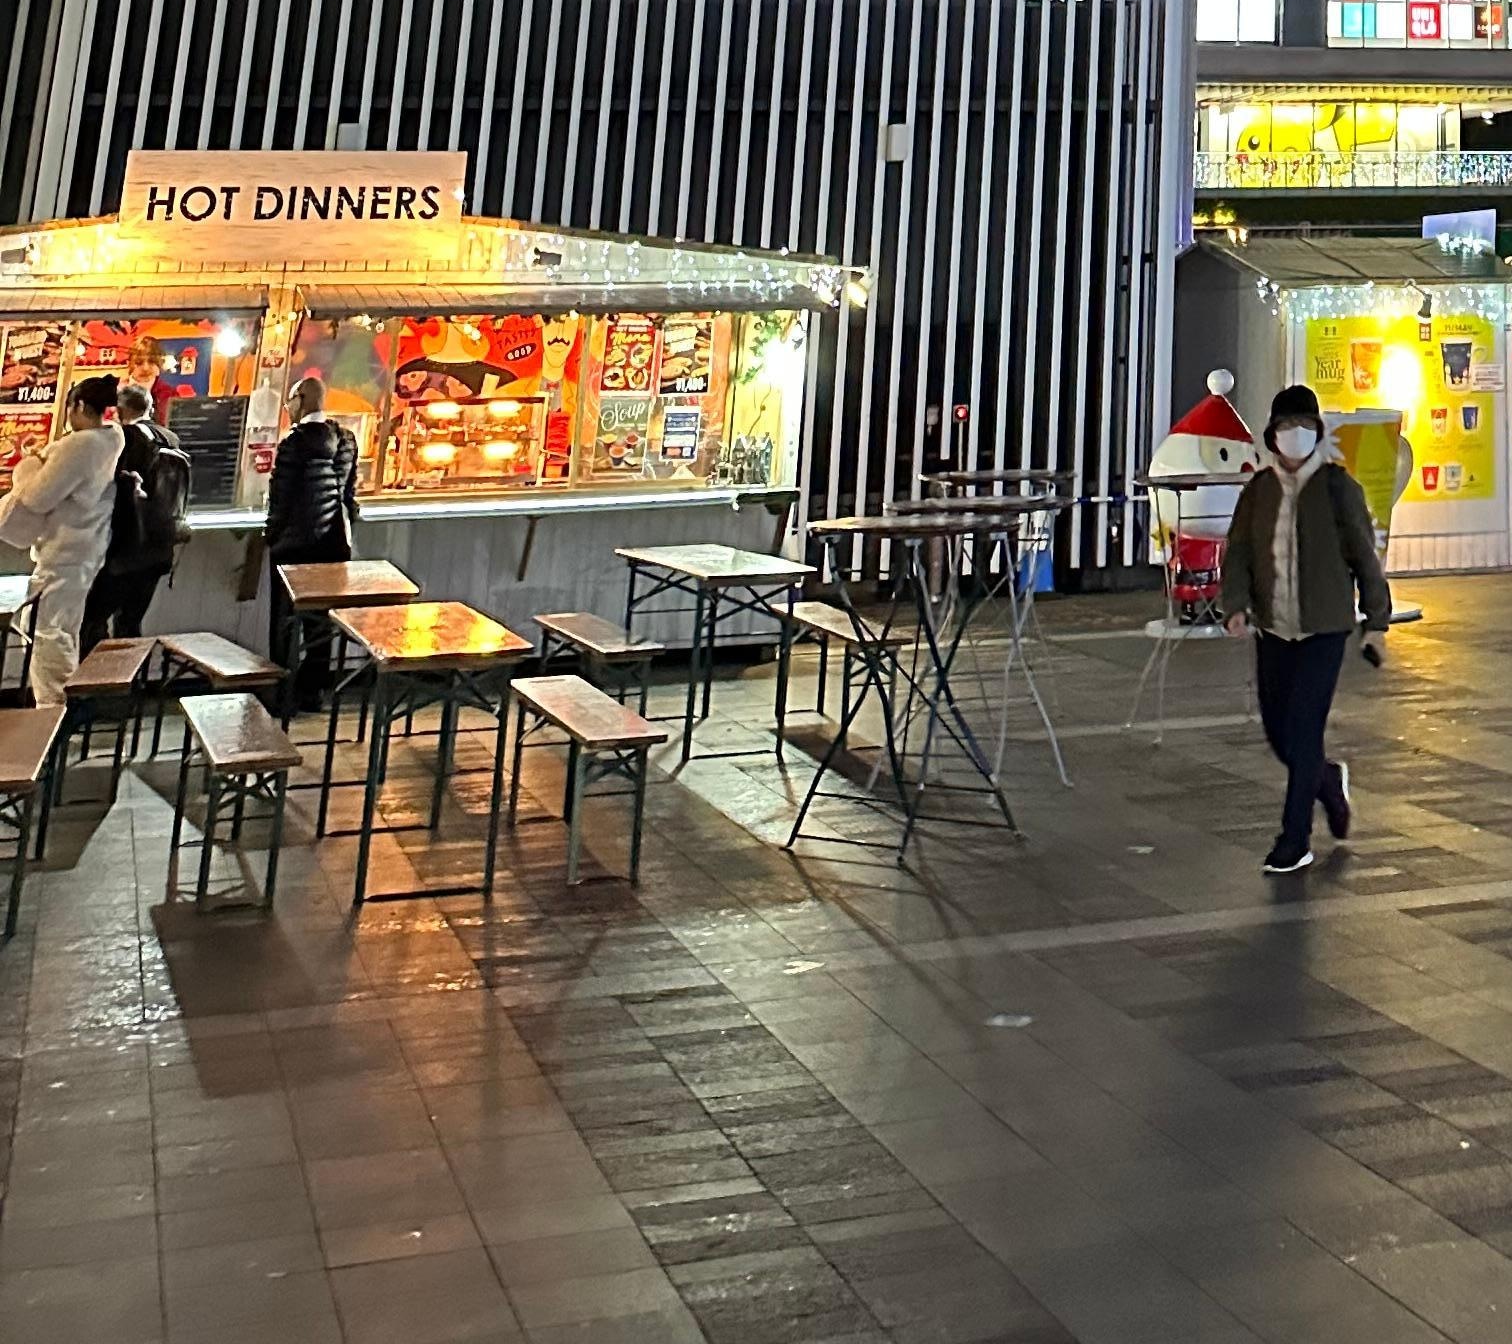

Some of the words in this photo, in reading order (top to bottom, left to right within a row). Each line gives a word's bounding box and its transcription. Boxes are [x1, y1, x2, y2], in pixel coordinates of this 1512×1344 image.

[146, 186, 241, 222] HOT
[253, 185, 441, 221] DINNERS
[600, 402, 645, 431] Soup
